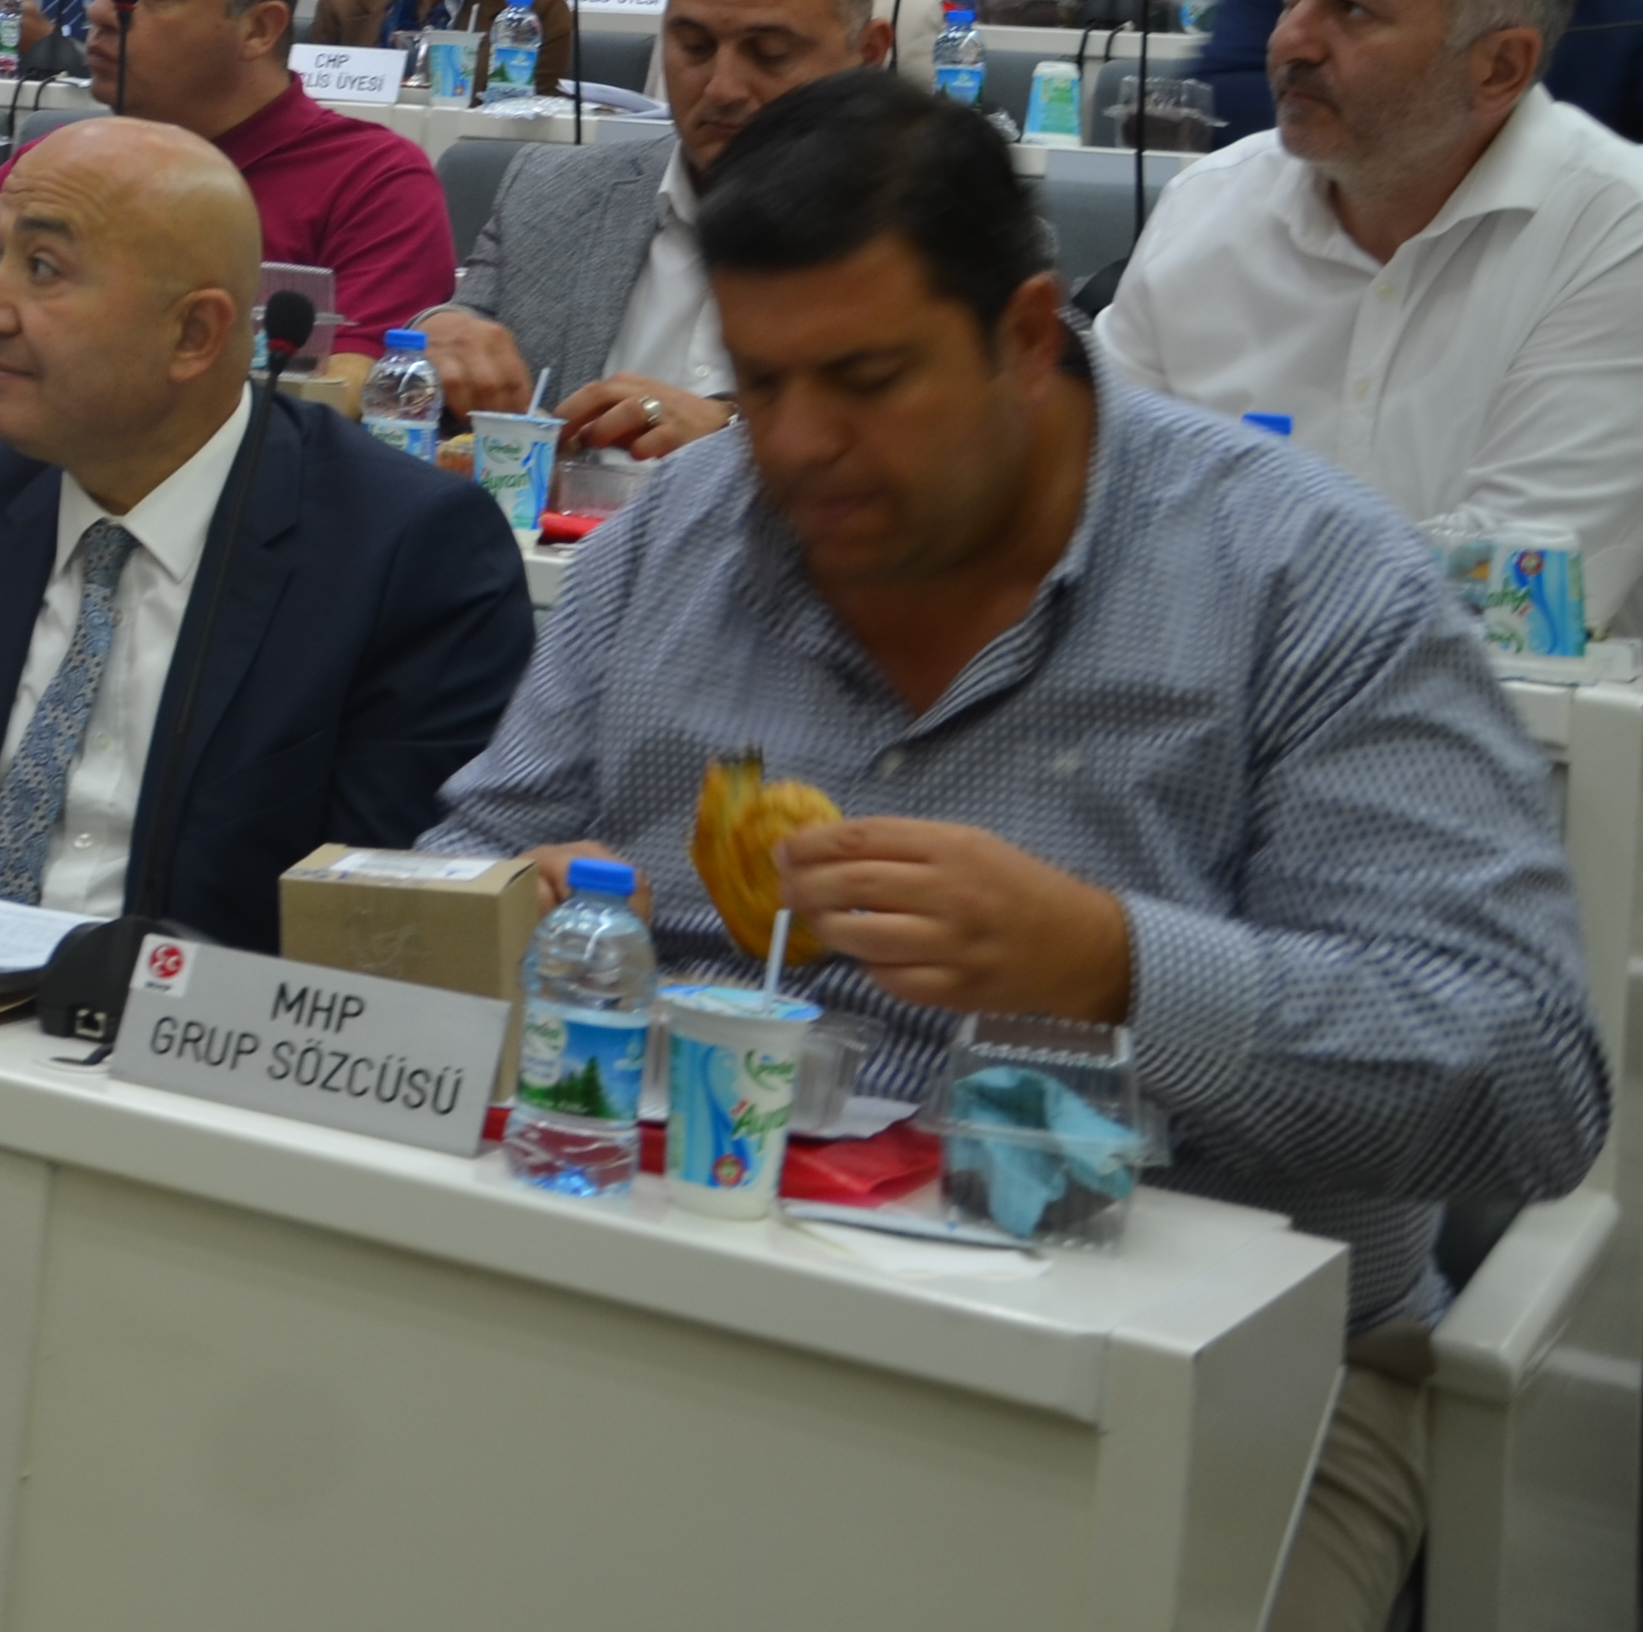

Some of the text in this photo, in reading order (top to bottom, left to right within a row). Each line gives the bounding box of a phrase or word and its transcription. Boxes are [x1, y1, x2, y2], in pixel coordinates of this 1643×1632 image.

[314, 52, 351, 70] CHP
[335, 71, 386, 93] ÜYESİ
[269, 979, 367, 1036] MHP
[149, 1015, 465, 1116] GRUP SÖZCÜSÜ
